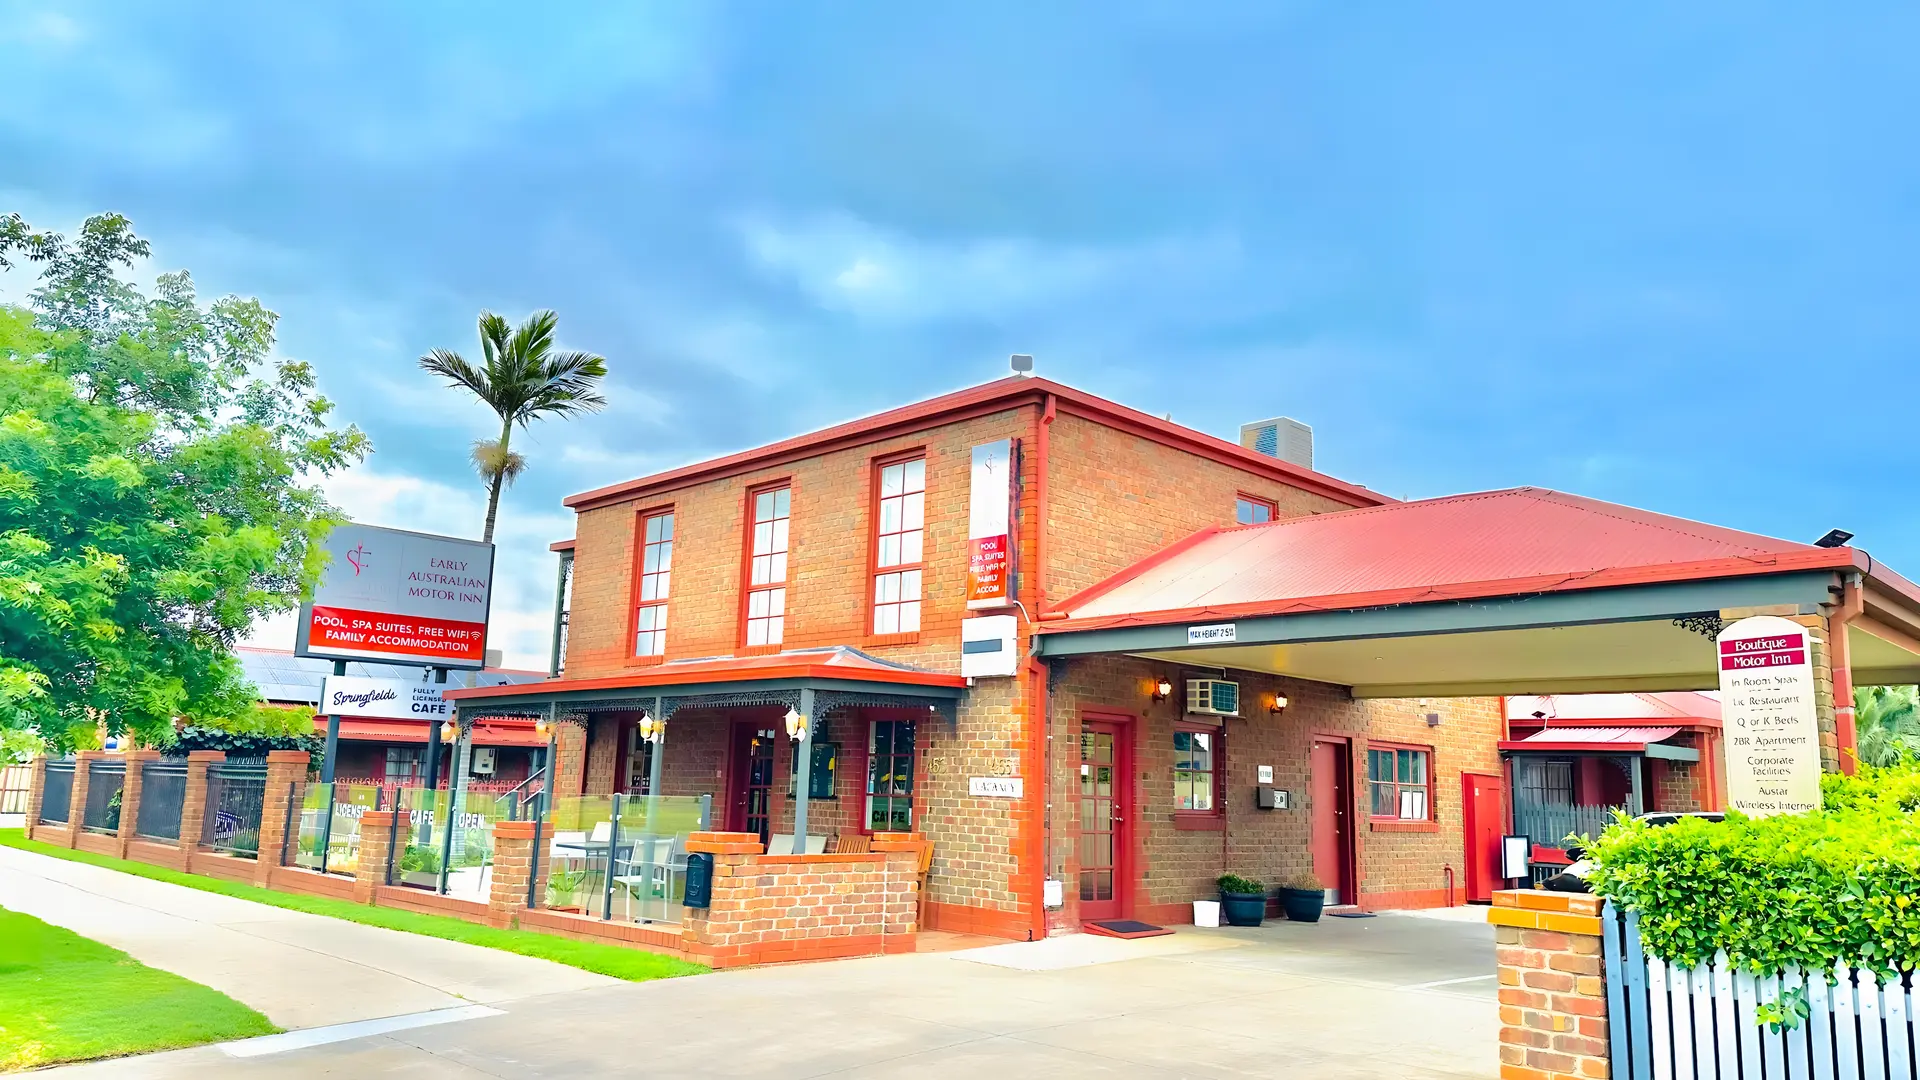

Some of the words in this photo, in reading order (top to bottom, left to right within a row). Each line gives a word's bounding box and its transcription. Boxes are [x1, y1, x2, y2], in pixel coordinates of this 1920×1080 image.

[980, 541, 998, 550] POOL
[971, 554, 984, 563] SPA
[984, 551, 1005, 561] SUITES
[430, 557, 468, 572] EARLY
[408, 571, 486, 589] AUSTRALIAN
[976, 573, 999, 584] FAMILY
[975, 584, 1000, 595] ACCOM
[408, 587, 455, 601] MOTOR
[459, 592, 483, 604] INN
[314, 615, 348, 629] POOL,
[352, 619, 373, 630] SPA
[375, 622, 415, 635] SUITES,
[418, 626, 444, 637] FREE
[447, 629, 469, 640] WIFI
[325, 630, 366, 643] FAMILY
[368, 634, 469, 652] ACCOMMODATION
[1735, 638, 1787, 652] Boutique
[1734, 656, 1767, 668] Motor
[1771, 654, 1792, 665] Inn
[1731, 678, 1741, 687] In
[1743, 677, 1771, 686] Room
[1774, 676, 1798, 686] Spas
[413, 687, 436, 695] FULLY
[333, 688, 398, 708] Springfields
[1733, 698, 1745, 707] Lic
[1749, 696, 1800, 706] Restaurant
[1736, 717, 1746, 728] Q
[1750, 718, 1760, 726] or
[1763, 716, 1771, 726] K
[1774, 715, 1799, 725] Beds
[1733, 737, 1751, 746] 2BR
[1755, 736, 1806, 747] Apartment
[1747, 756, 1795, 767] Corporate
[1752, 766, 1791, 776] Facilities
[1758, 786, 1788, 796] Austar
[1735, 800, 1776, 810] Wireless
[1778, 801, 1816, 811] Internet
[409, 809, 434, 825] CAFE
[458, 812, 485, 830] OPEN
